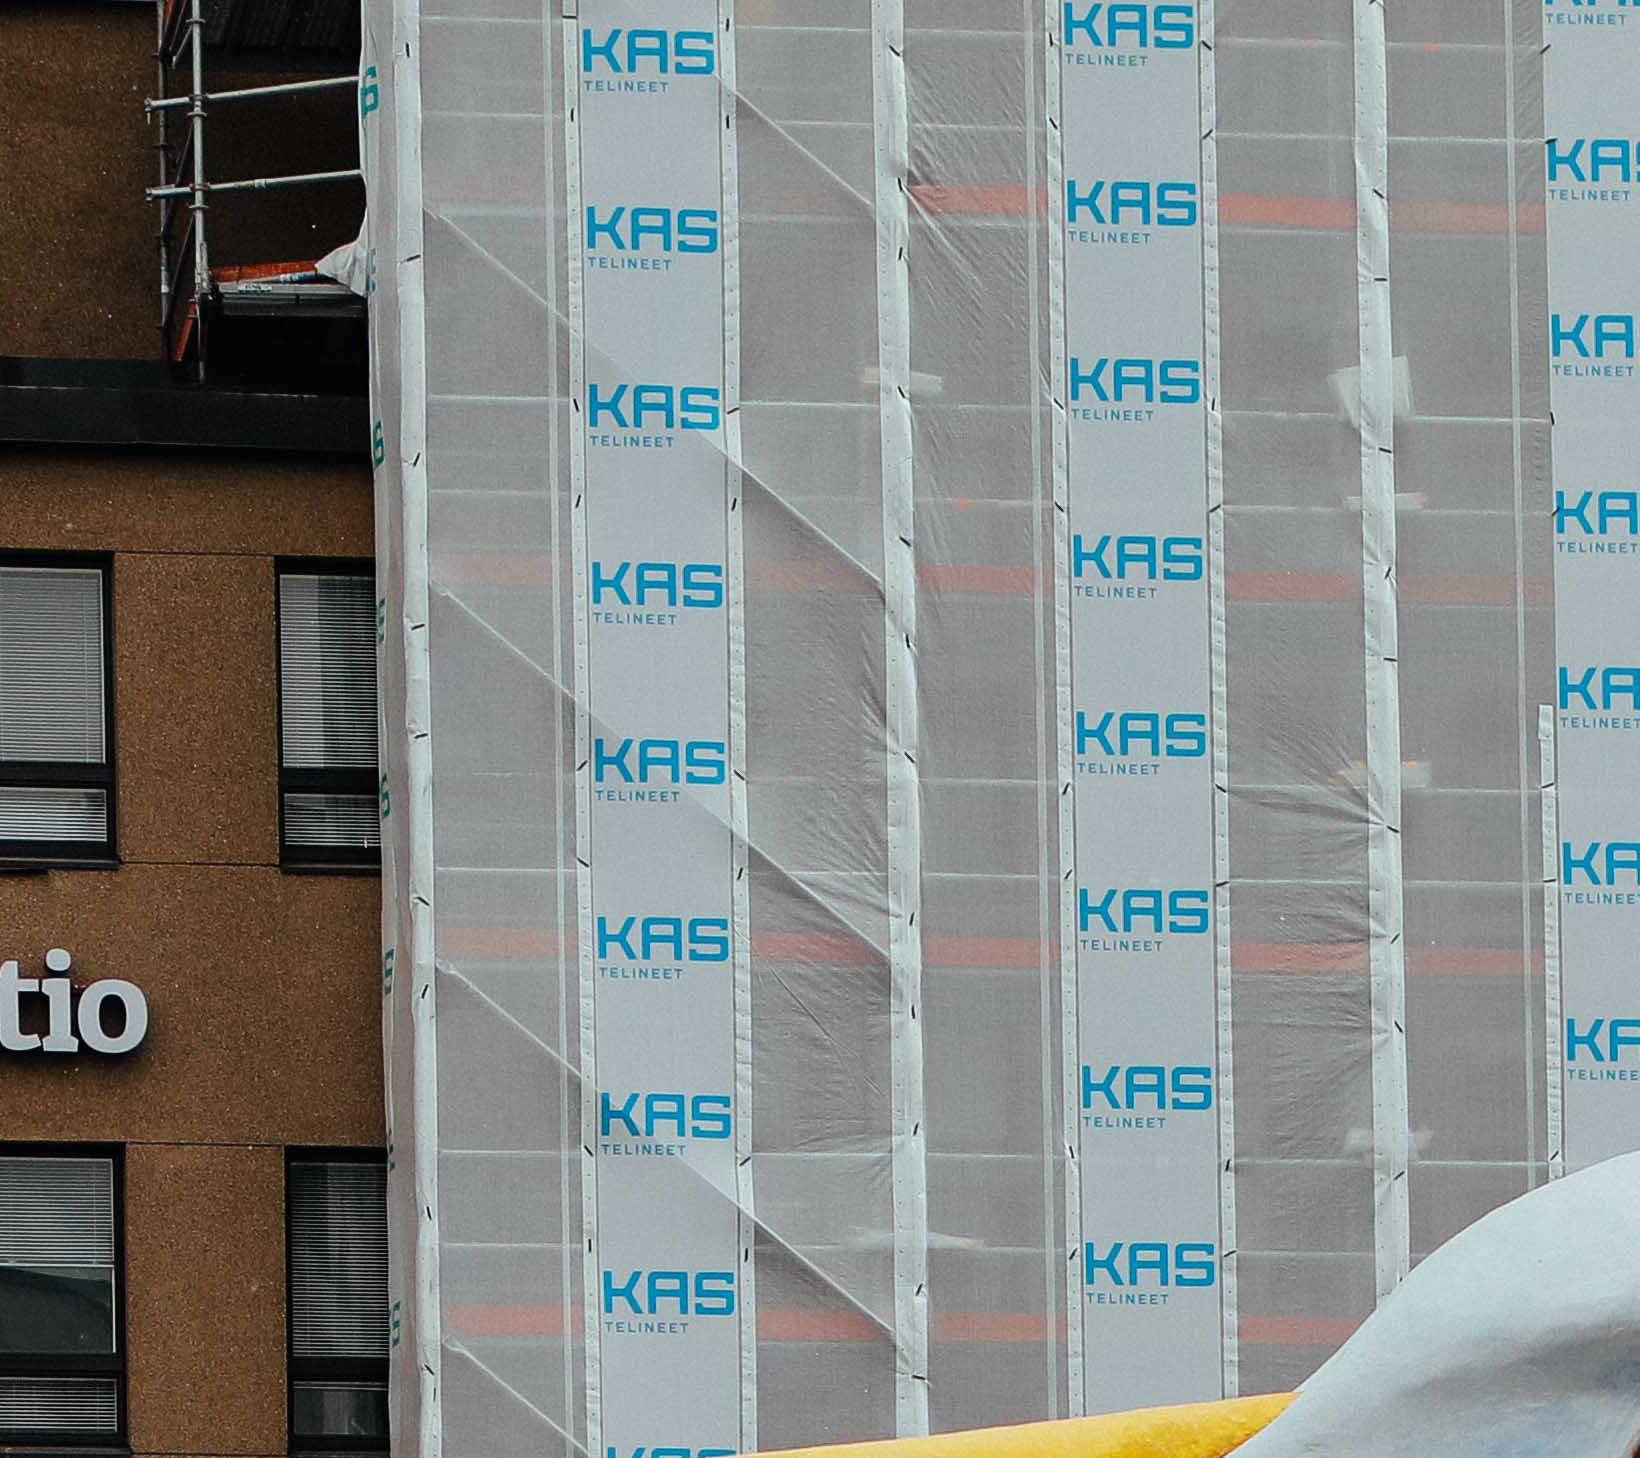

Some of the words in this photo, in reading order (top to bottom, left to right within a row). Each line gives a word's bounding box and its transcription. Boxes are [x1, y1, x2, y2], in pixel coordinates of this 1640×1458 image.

[1064, 2, 1194, 48] KAS
[1545, 13, 1627, 25] TELINEET
[583, 29, 715, 74] KAS
[1065, 52, 1150, 67] TELINEET
[584, 78, 669, 93] TELINEET
[1549, 187, 1630, 202] TELINEET
[1067, 180, 1196, 226] KAS
[587, 206, 718, 253] KAS
[1068, 230, 1153, 245] TELINEET
[588, 257, 673, 272] TELINEET
[1553, 363, 1634, 378] TELINEET
[1070, 358, 1200, 403] KAS
[589, 384, 720, 430] KAS
[1071, 407, 1156, 422] TELINEET
[590, 434, 675, 449] TELINEET
[1557, 539, 1638, 554] TELINEET
[1073, 535, 1203, 580] KAS
[592, 562, 723, 608] KAS
[1074, 584, 1159, 599] TELINEET
[593, 612, 678, 627] TELINEET
[1076, 712, 1206, 757] KAS
[595, 738, 725, 784] KAS
[1077, 761, 1162, 776] TELINEET
[596, 788, 681, 803] TELINEET
[1080, 888, 1208, 933] KAS
[597, 916, 728, 961] KAS
[1081, 937, 1166, 952] TELINEET
[598, 965, 683, 980] TELINEET
[1082, 1065, 1212, 1110] KAS
[601, 1092, 731, 1139] KAS
[1083, 1114, 1168, 1129] TELINEET
[602, 1143, 687, 1158] TELINEET
[1085, 1242, 1215, 1286] KAS
[603, 1271, 735, 1315] KAS
[1086, 1290, 1171, 1305] TELINEET
[604, 1319, 689, 1334] TELINEET
